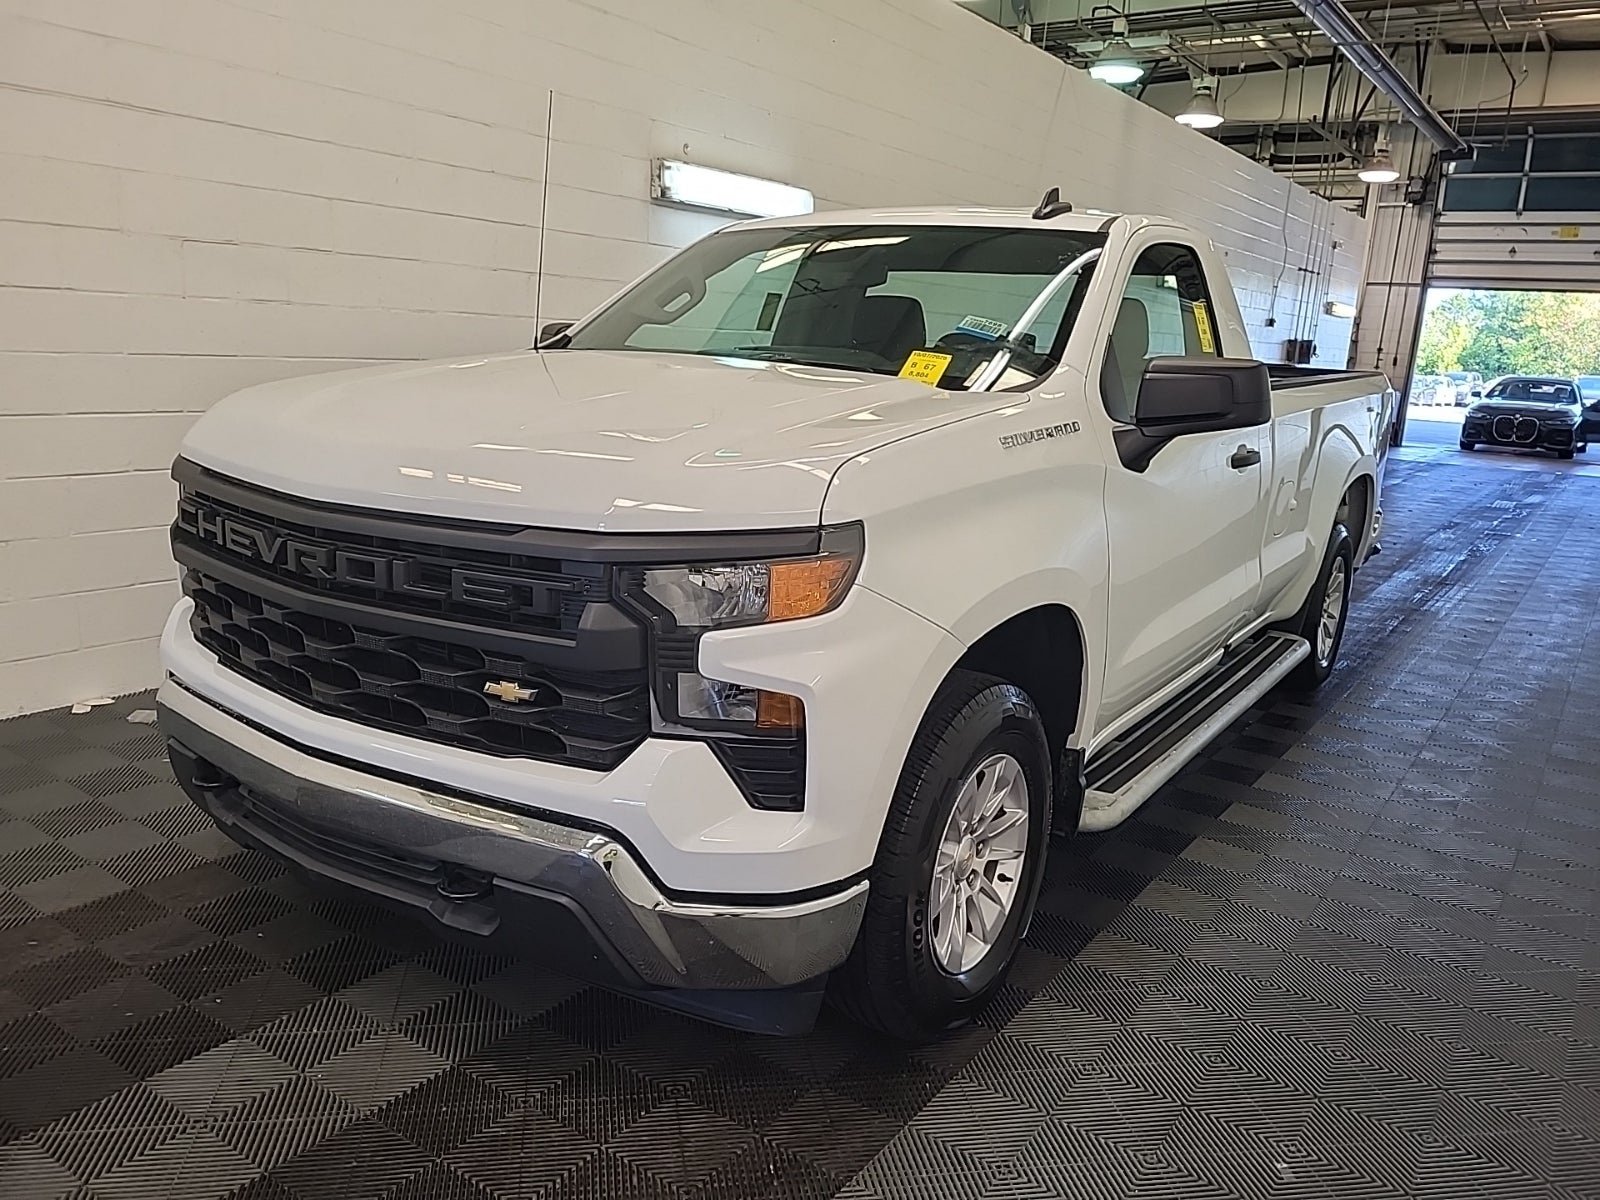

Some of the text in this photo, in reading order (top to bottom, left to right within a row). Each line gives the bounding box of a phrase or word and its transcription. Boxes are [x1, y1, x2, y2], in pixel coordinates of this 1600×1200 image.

[923, 363, 937, 371] 67
[998, 421, 1081, 449] SILVERADO
[178, 500, 587, 613] CHEVROLET
